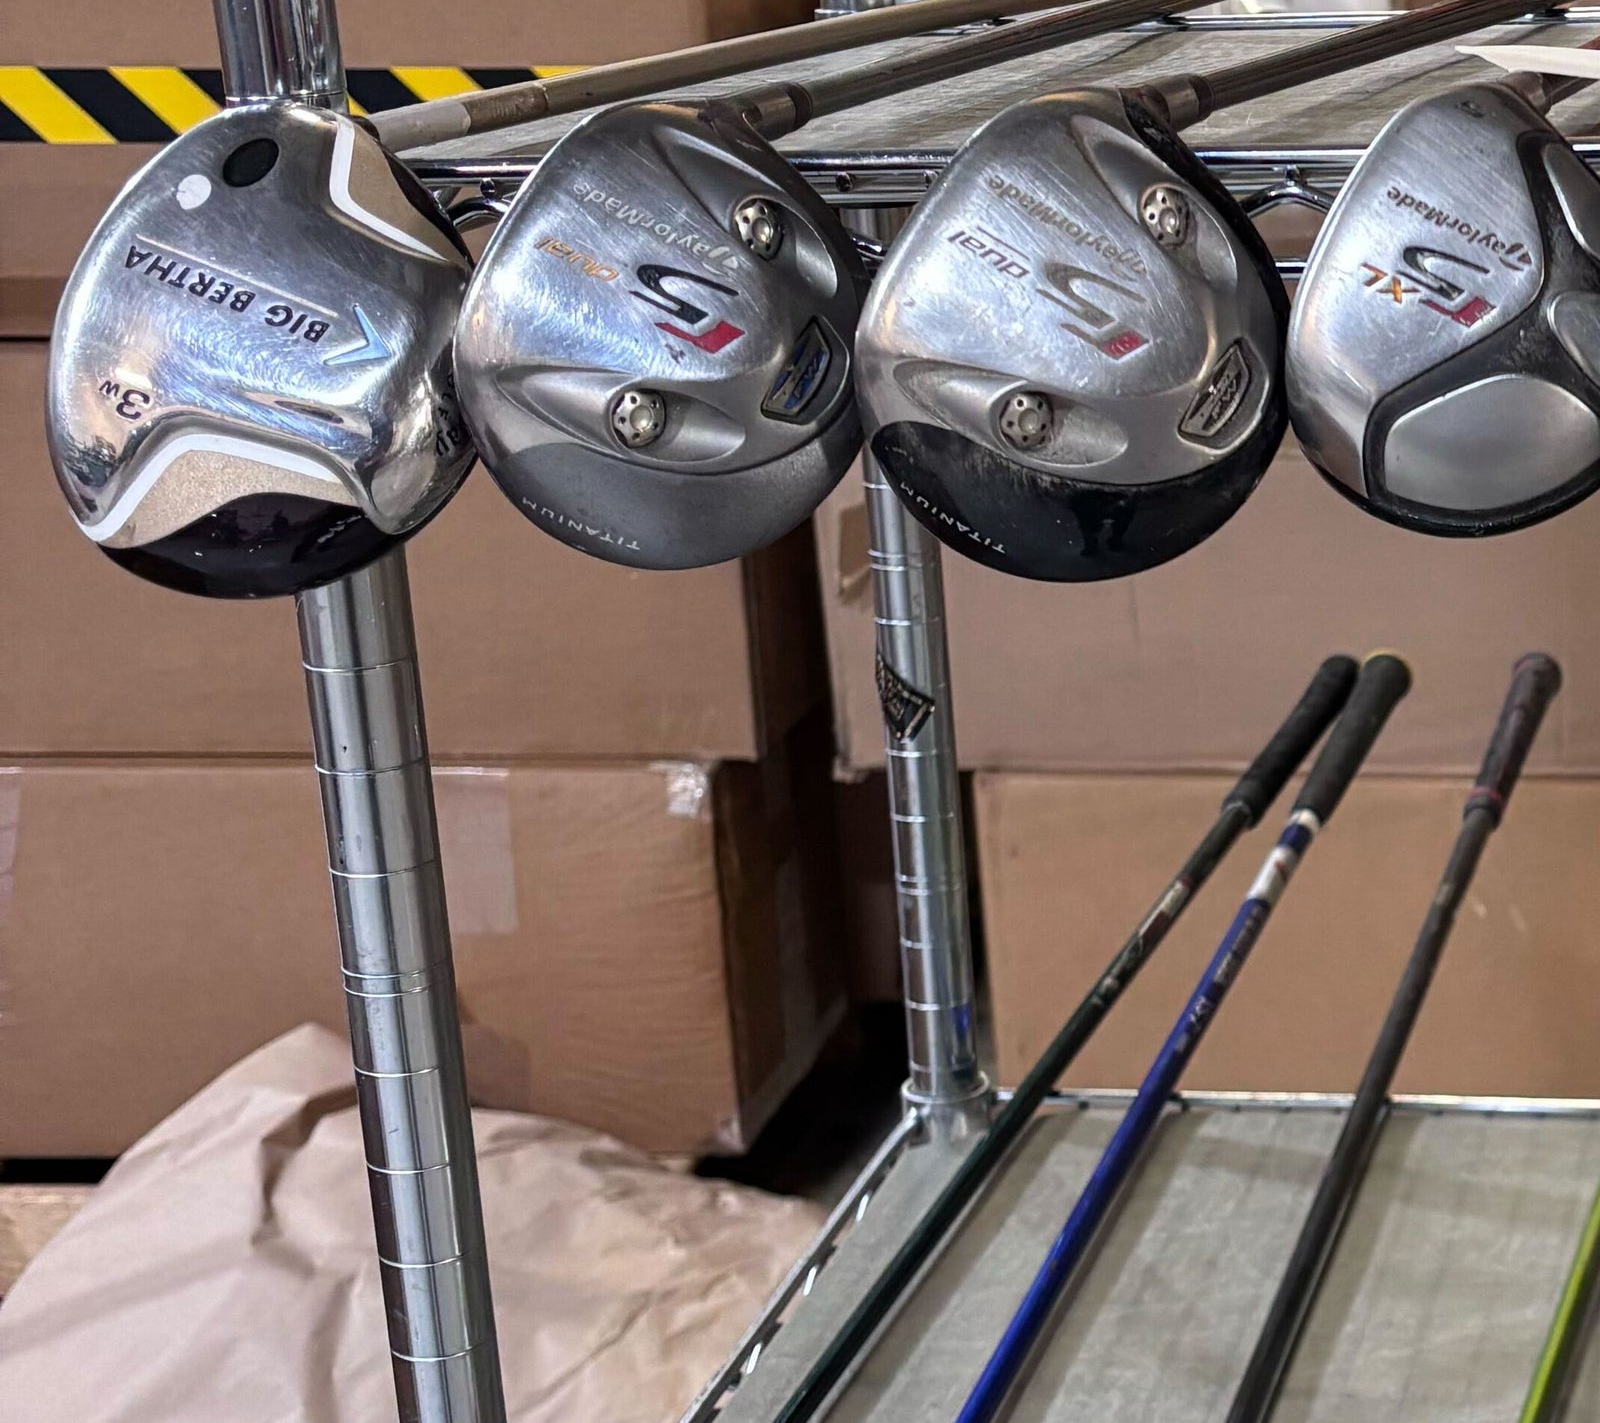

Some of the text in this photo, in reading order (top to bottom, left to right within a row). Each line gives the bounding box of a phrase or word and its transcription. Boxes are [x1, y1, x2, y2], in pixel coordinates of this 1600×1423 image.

[533, 234, 621, 284] dual
[568, 177, 736, 274] TaylorMade
[946, 227, 1030, 281] dual
[984, 171, 1146, 281] TaylorMade
[1385, 187, 1531, 270] TaylorMade
[123, 243, 330, 343] BIG BERTHA
[1359, 262, 1418, 304] XL
[518, 495, 639, 551] TITANIUM
[897, 480, 1006, 553] TITANIUM
